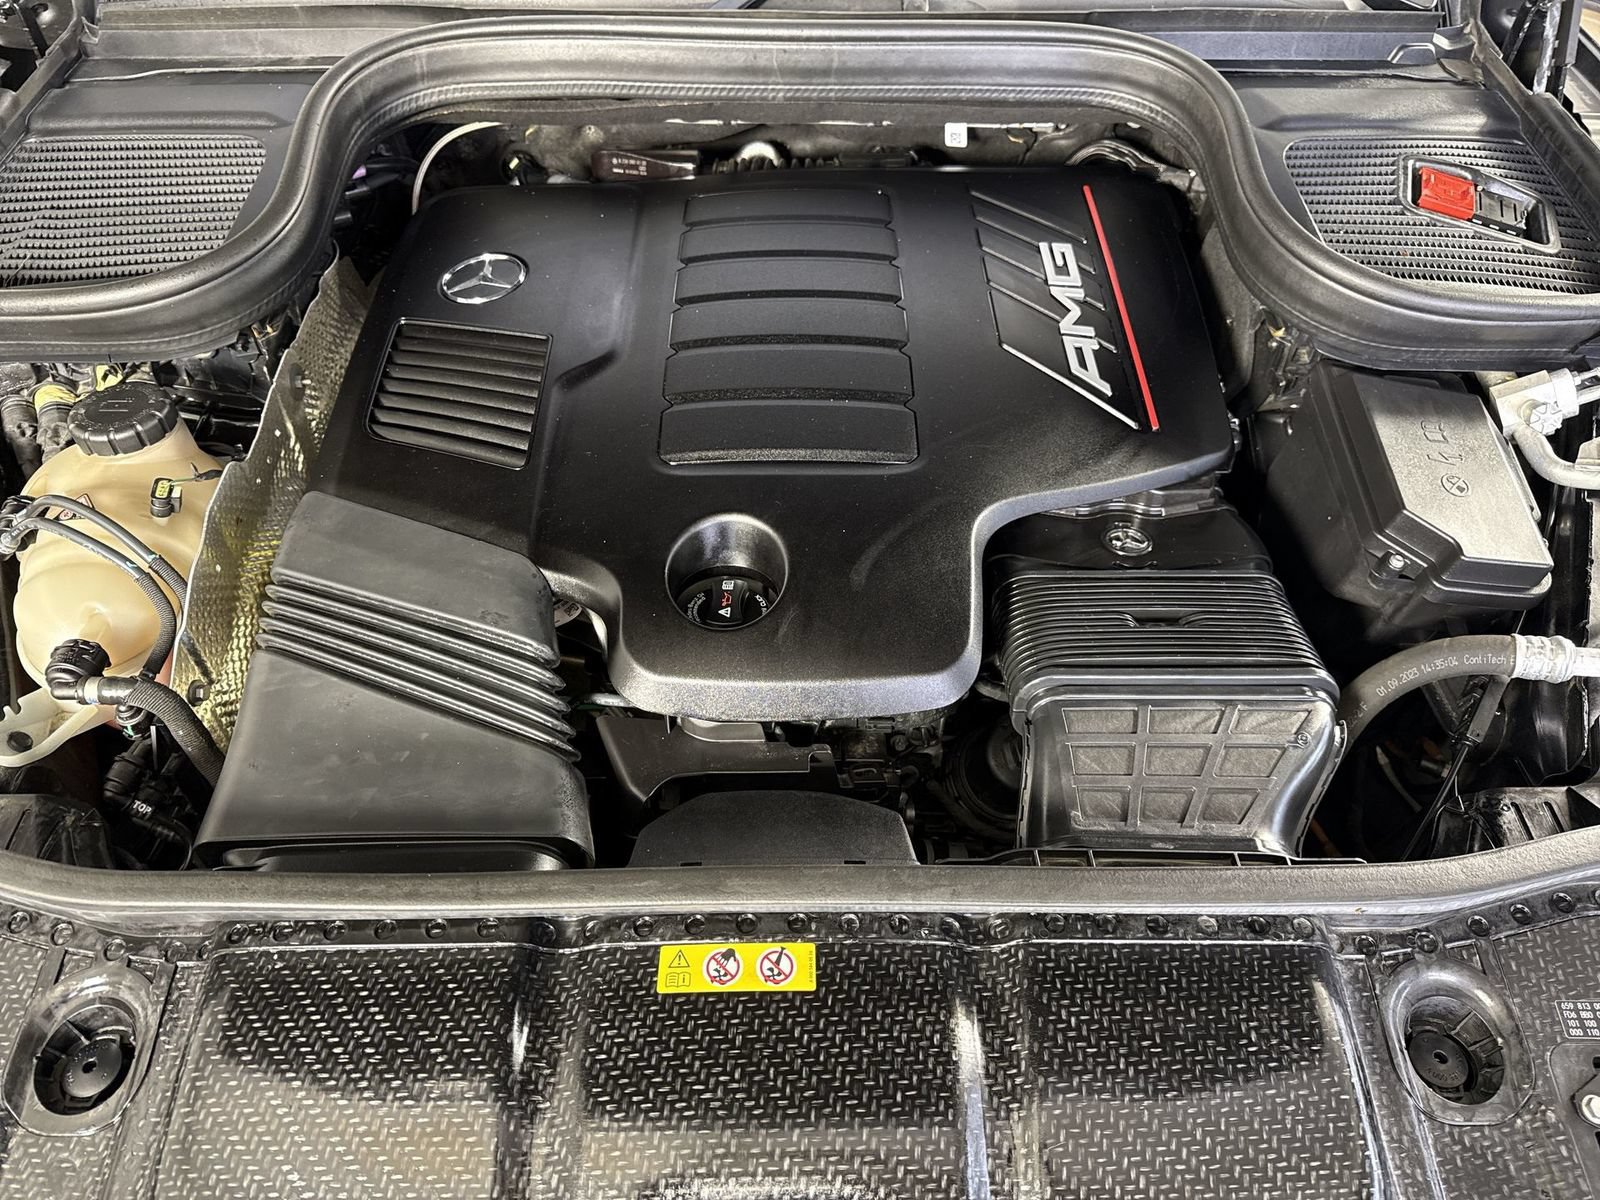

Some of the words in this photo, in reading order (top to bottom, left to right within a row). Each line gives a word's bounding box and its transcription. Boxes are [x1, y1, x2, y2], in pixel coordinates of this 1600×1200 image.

[1038, 241, 1113, 397] AMG
[1376, 667, 1420, 697] 01.09.2023
[1421, 656, 1459, 674] 14:35:04
[1463, 654, 1507, 665] ContiTech
[132, 800, 152, 814] TOP
[1561, 1002, 1574, 1010] 659
[1577, 1002, 1591, 1010] 813
